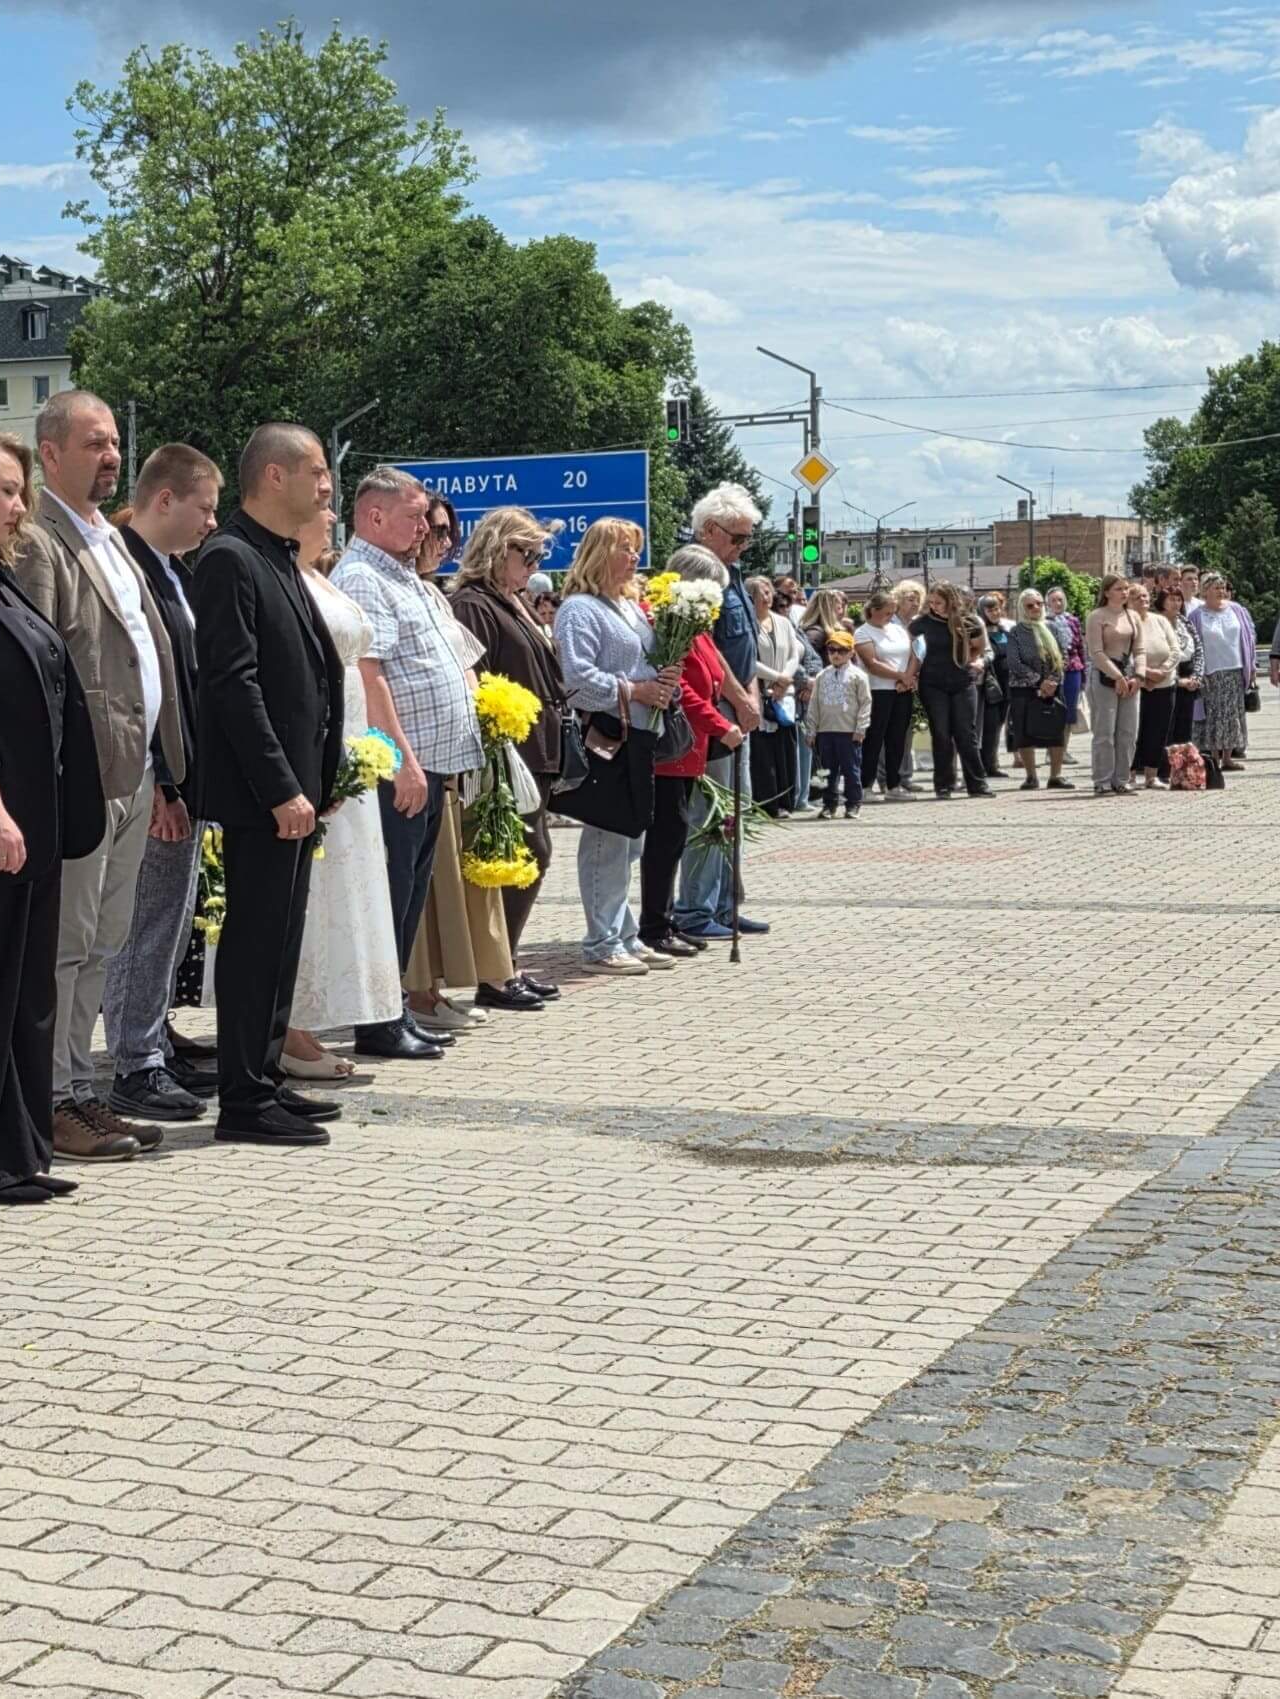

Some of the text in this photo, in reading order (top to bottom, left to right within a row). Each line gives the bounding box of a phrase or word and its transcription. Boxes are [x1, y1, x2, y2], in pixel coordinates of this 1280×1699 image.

[422, 471, 588, 494] СЛАВУТА 20
[568, 515, 588, 533] 16
